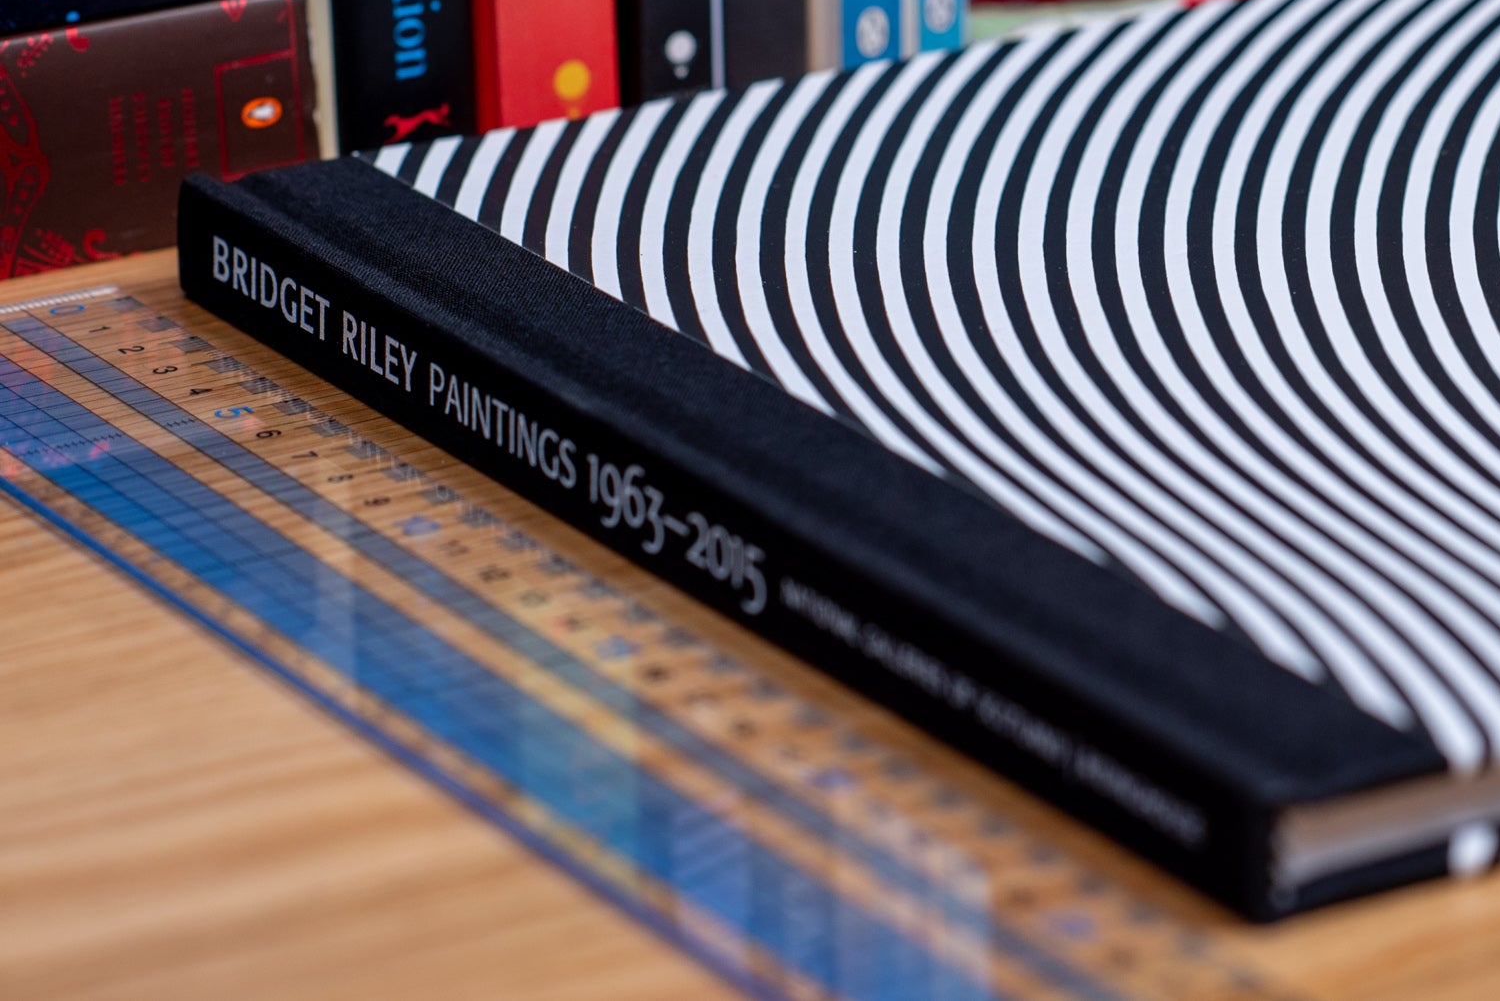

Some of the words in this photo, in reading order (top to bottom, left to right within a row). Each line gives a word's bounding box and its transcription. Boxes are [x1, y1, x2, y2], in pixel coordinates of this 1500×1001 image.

[118, 345, 145, 355] 2
[152, 365, 178, 375] 3
[188, 387, 213, 397] 4
[214, 406, 254, 419] 5
[256, 429, 282, 440] 6
[213, 235, 330, 341] BRIDGET
[342, 310, 417, 392] RILEY
[429, 362, 577, 488] PAINTINGS
